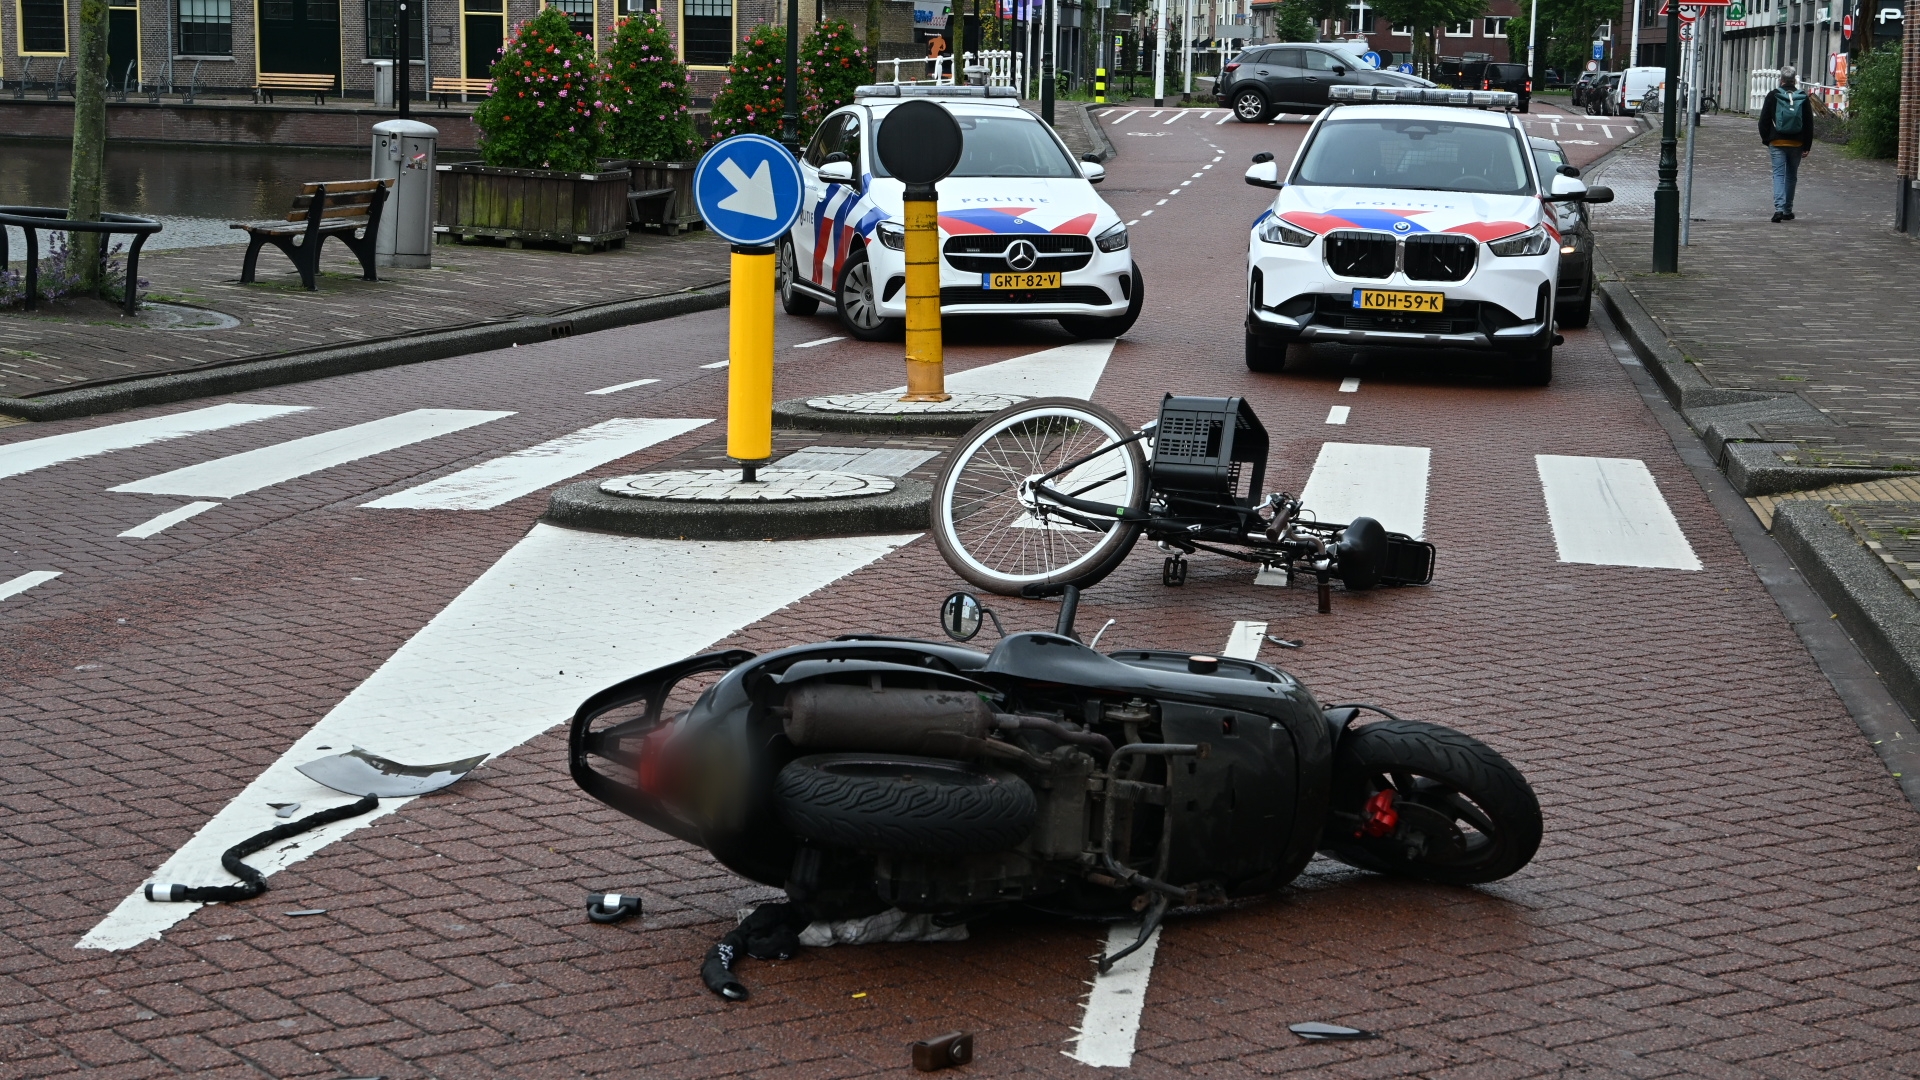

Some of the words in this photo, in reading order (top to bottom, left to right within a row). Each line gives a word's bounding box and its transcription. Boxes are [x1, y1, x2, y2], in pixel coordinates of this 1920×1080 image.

[1355, 201, 1455, 210] POLITIE
[994, 274, 1056, 287] GRT-82-V
[1364, 292, 1439, 310] KDH-59-K
